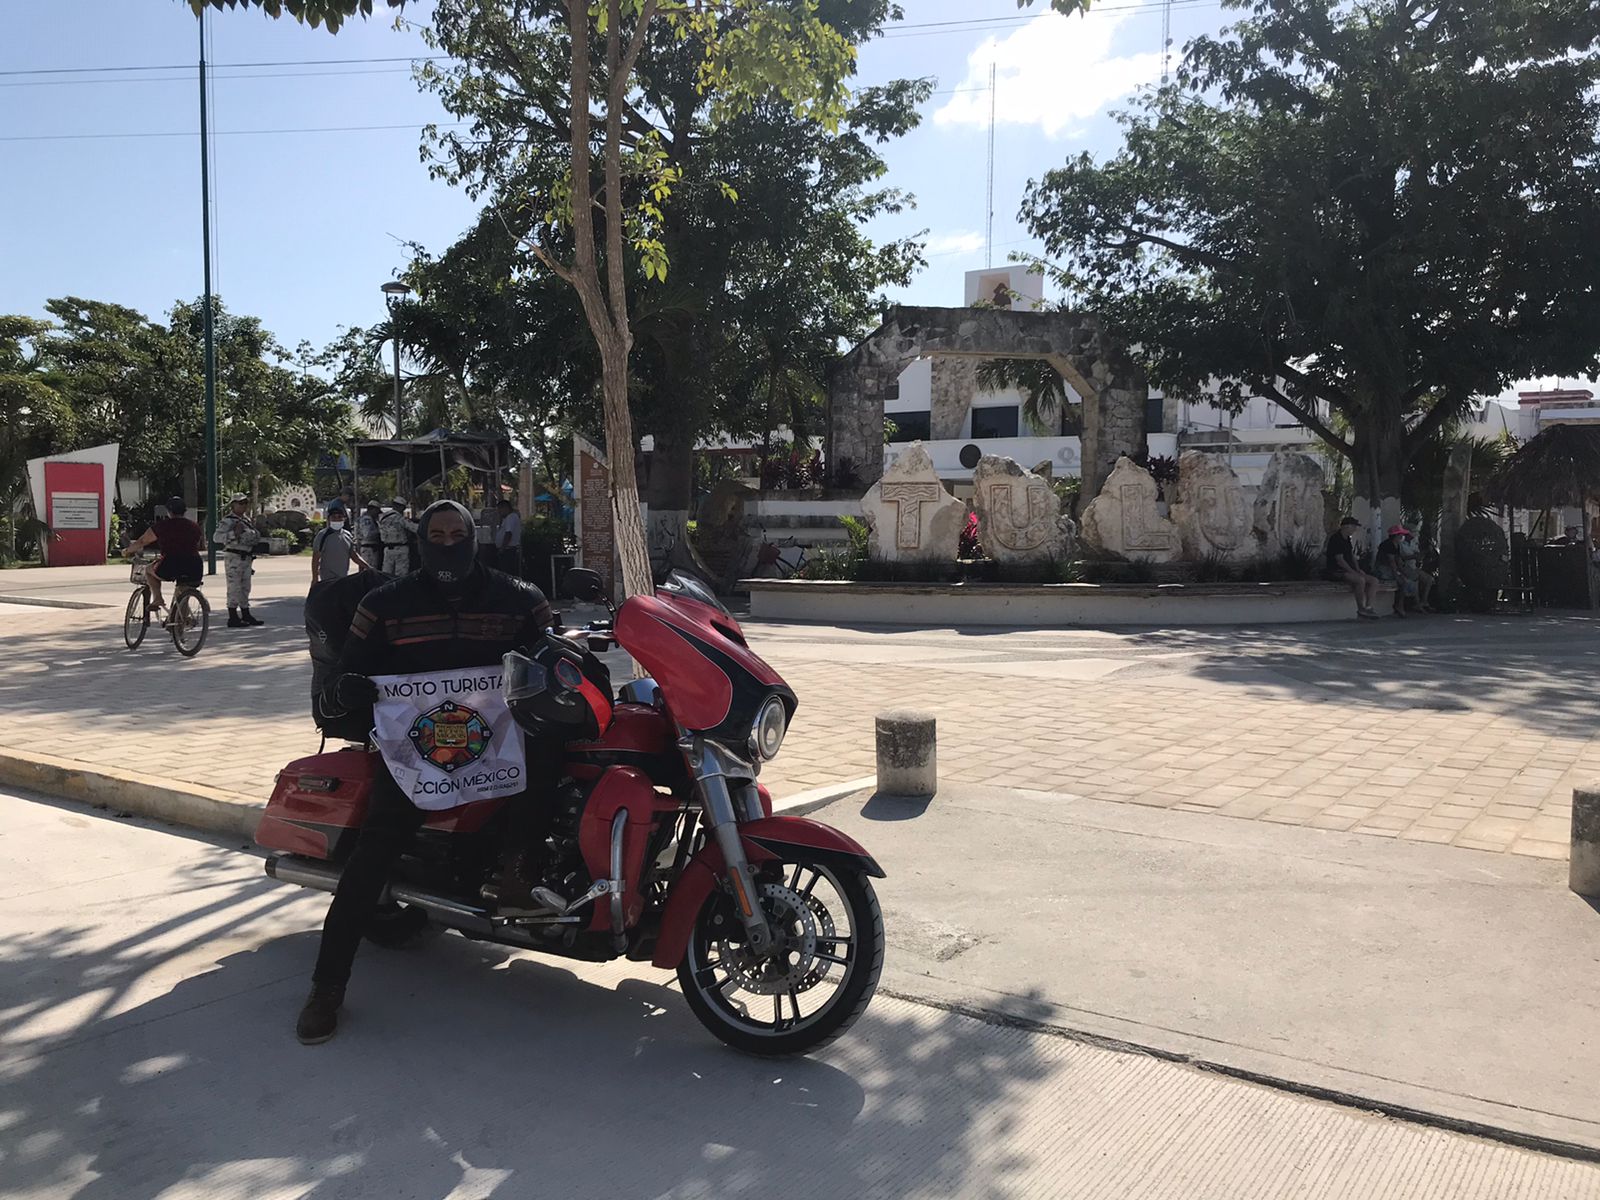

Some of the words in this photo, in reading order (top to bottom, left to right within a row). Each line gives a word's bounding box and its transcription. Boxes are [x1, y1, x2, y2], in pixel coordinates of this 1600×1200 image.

[881, 482, 1321, 550] TULUM
[384, 681, 436, 697] MOTO
[463, 766, 520, 788] MÉXICO
